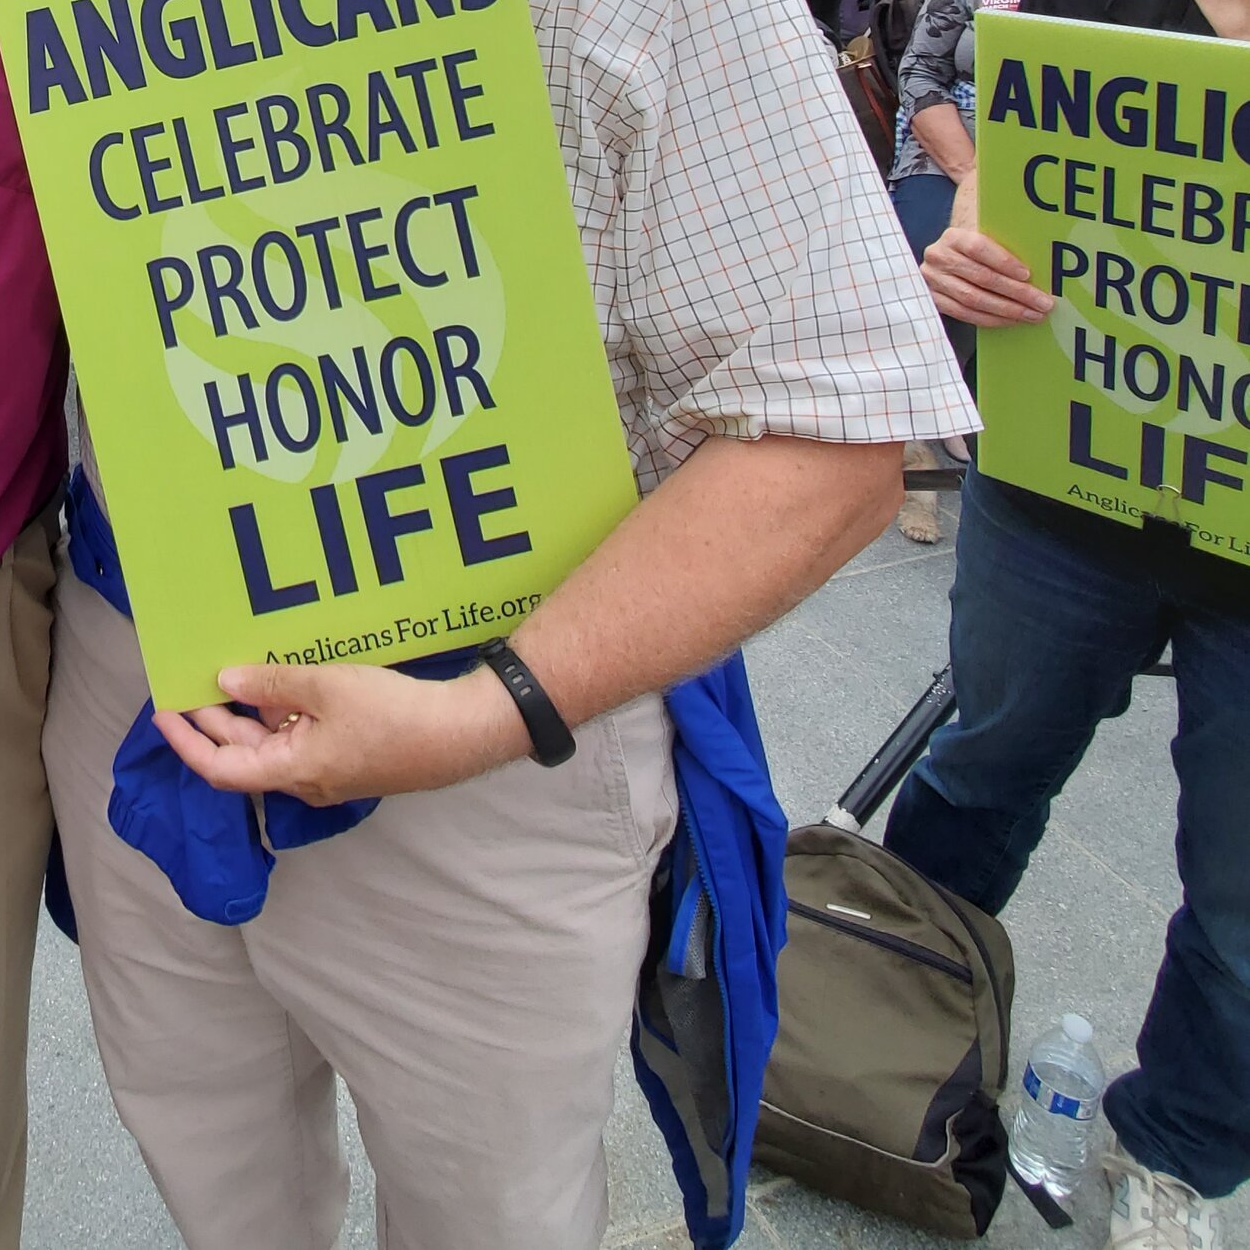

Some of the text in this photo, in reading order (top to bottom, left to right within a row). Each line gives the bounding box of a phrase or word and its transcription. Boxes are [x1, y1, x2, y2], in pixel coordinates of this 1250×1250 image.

[87, 48, 496, 222] CELEBRATE
[145, 185, 482, 350] PROTECT
[203, 324, 497, 471] HONOR
[228, 443, 533, 616] LIFE
